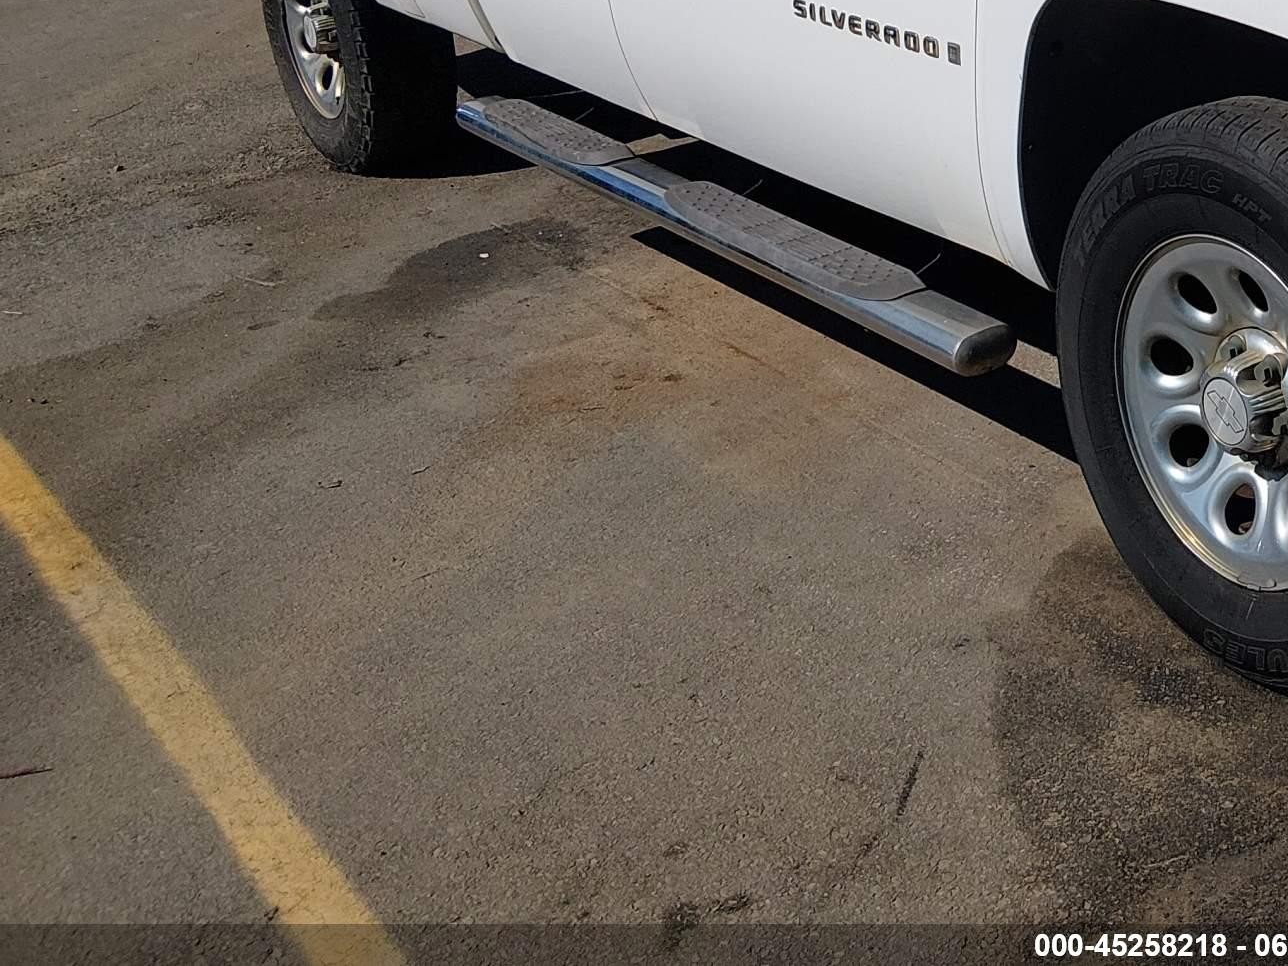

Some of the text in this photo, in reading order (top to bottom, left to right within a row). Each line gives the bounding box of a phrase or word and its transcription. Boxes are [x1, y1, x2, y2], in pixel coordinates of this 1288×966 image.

[1072, 162, 1273, 267] TERRA TRAC HPT
